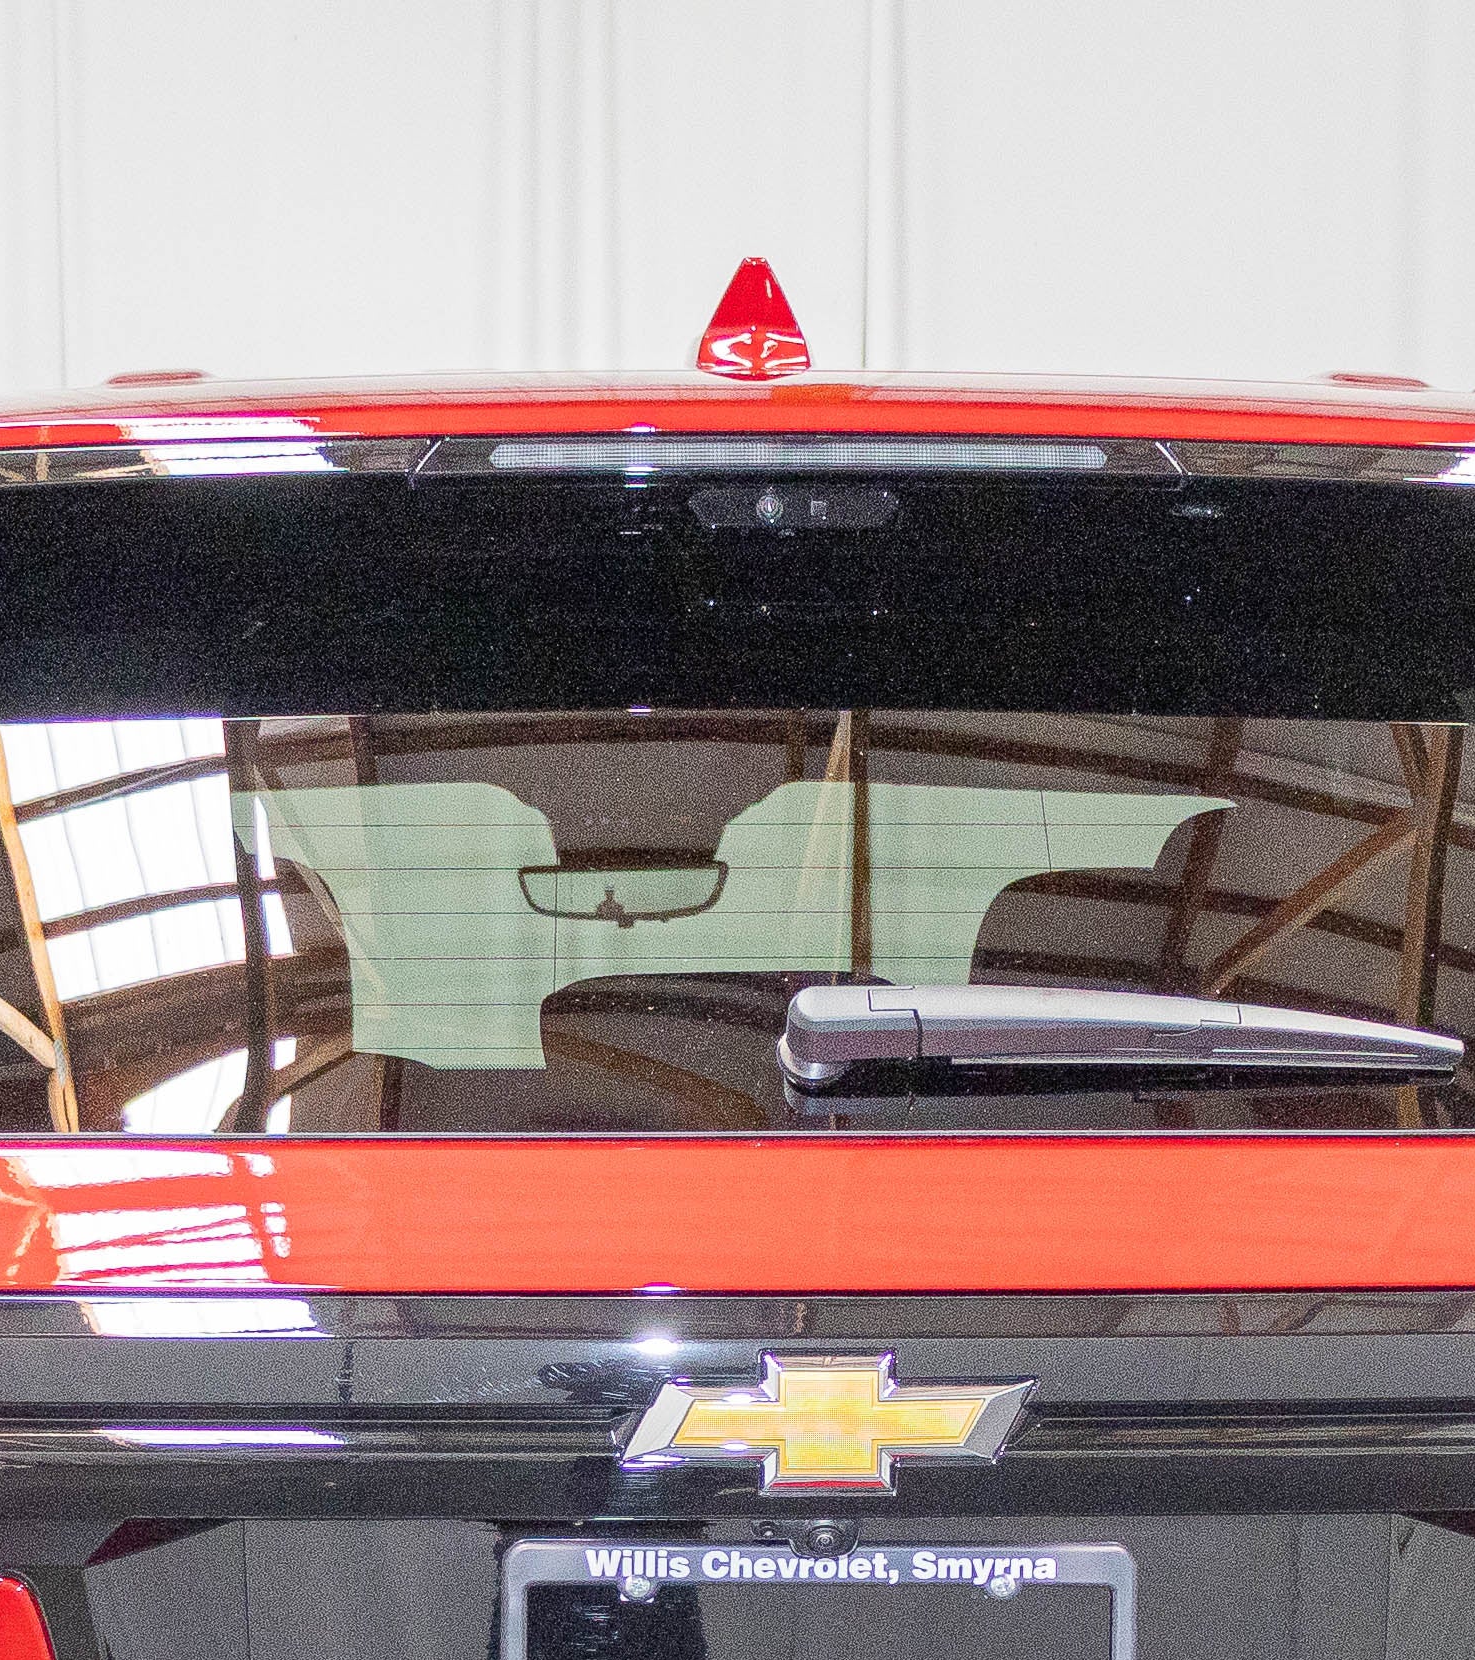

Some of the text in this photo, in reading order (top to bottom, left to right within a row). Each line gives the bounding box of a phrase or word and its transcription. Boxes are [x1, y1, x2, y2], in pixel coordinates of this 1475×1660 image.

[585, 1549, 1057, 1585] Willis Chevrolet, Smyrna
